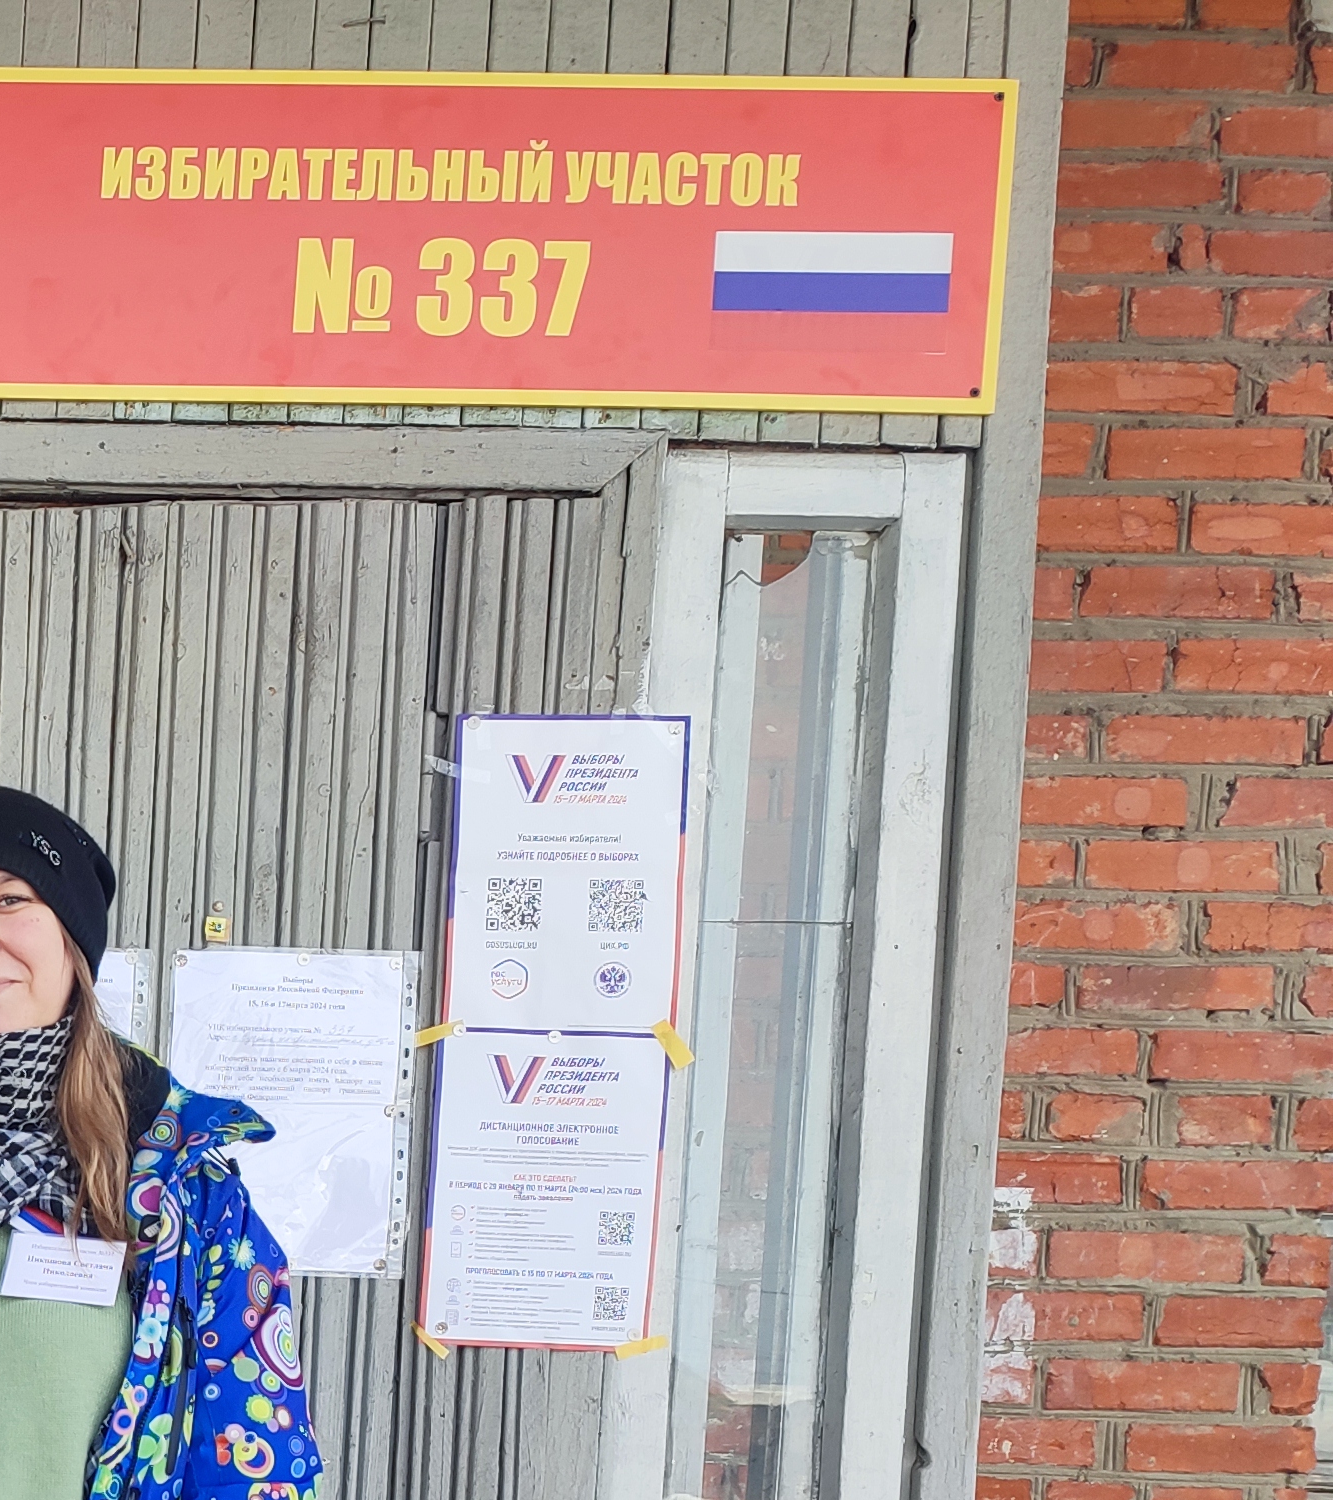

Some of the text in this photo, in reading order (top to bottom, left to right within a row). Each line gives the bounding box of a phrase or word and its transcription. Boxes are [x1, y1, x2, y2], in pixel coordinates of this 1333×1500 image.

[100, 140, 801, 207] ИЗБИРАТЕЛЬНЫЙ УЧАСТОК
[292, 237, 591, 336] № 337
[571, 754, 625, 765] ВЫБОРЫ
[564, 768, 640, 779] ПРЕЗИДЕНТА
[558, 782, 607, 791] РОССИИ
[497, 850, 534, 860] УЗНАЙТЕ
[537, 852, 588, 861] ПОДРОБНЕЕ
[598, 852, 639, 861] ВЫБОРАХ
[310, 1002, 327, 1010] 2024
[551, 1057, 605, 1068] ВЫБОРЫ
[544, 1071, 620, 1082] ПРЕЗИДЕНТА
[537, 1084, 587, 1094] РОССИИ
[557, 1097, 585, 1106] МАРТА
[480, 1122, 619, 1134] ДИСТАНЦИОННОЕ ЭЛЕКТРОННОЕ
[517, 1136, 579, 1146] ГОЛОСОВАНИЕ
